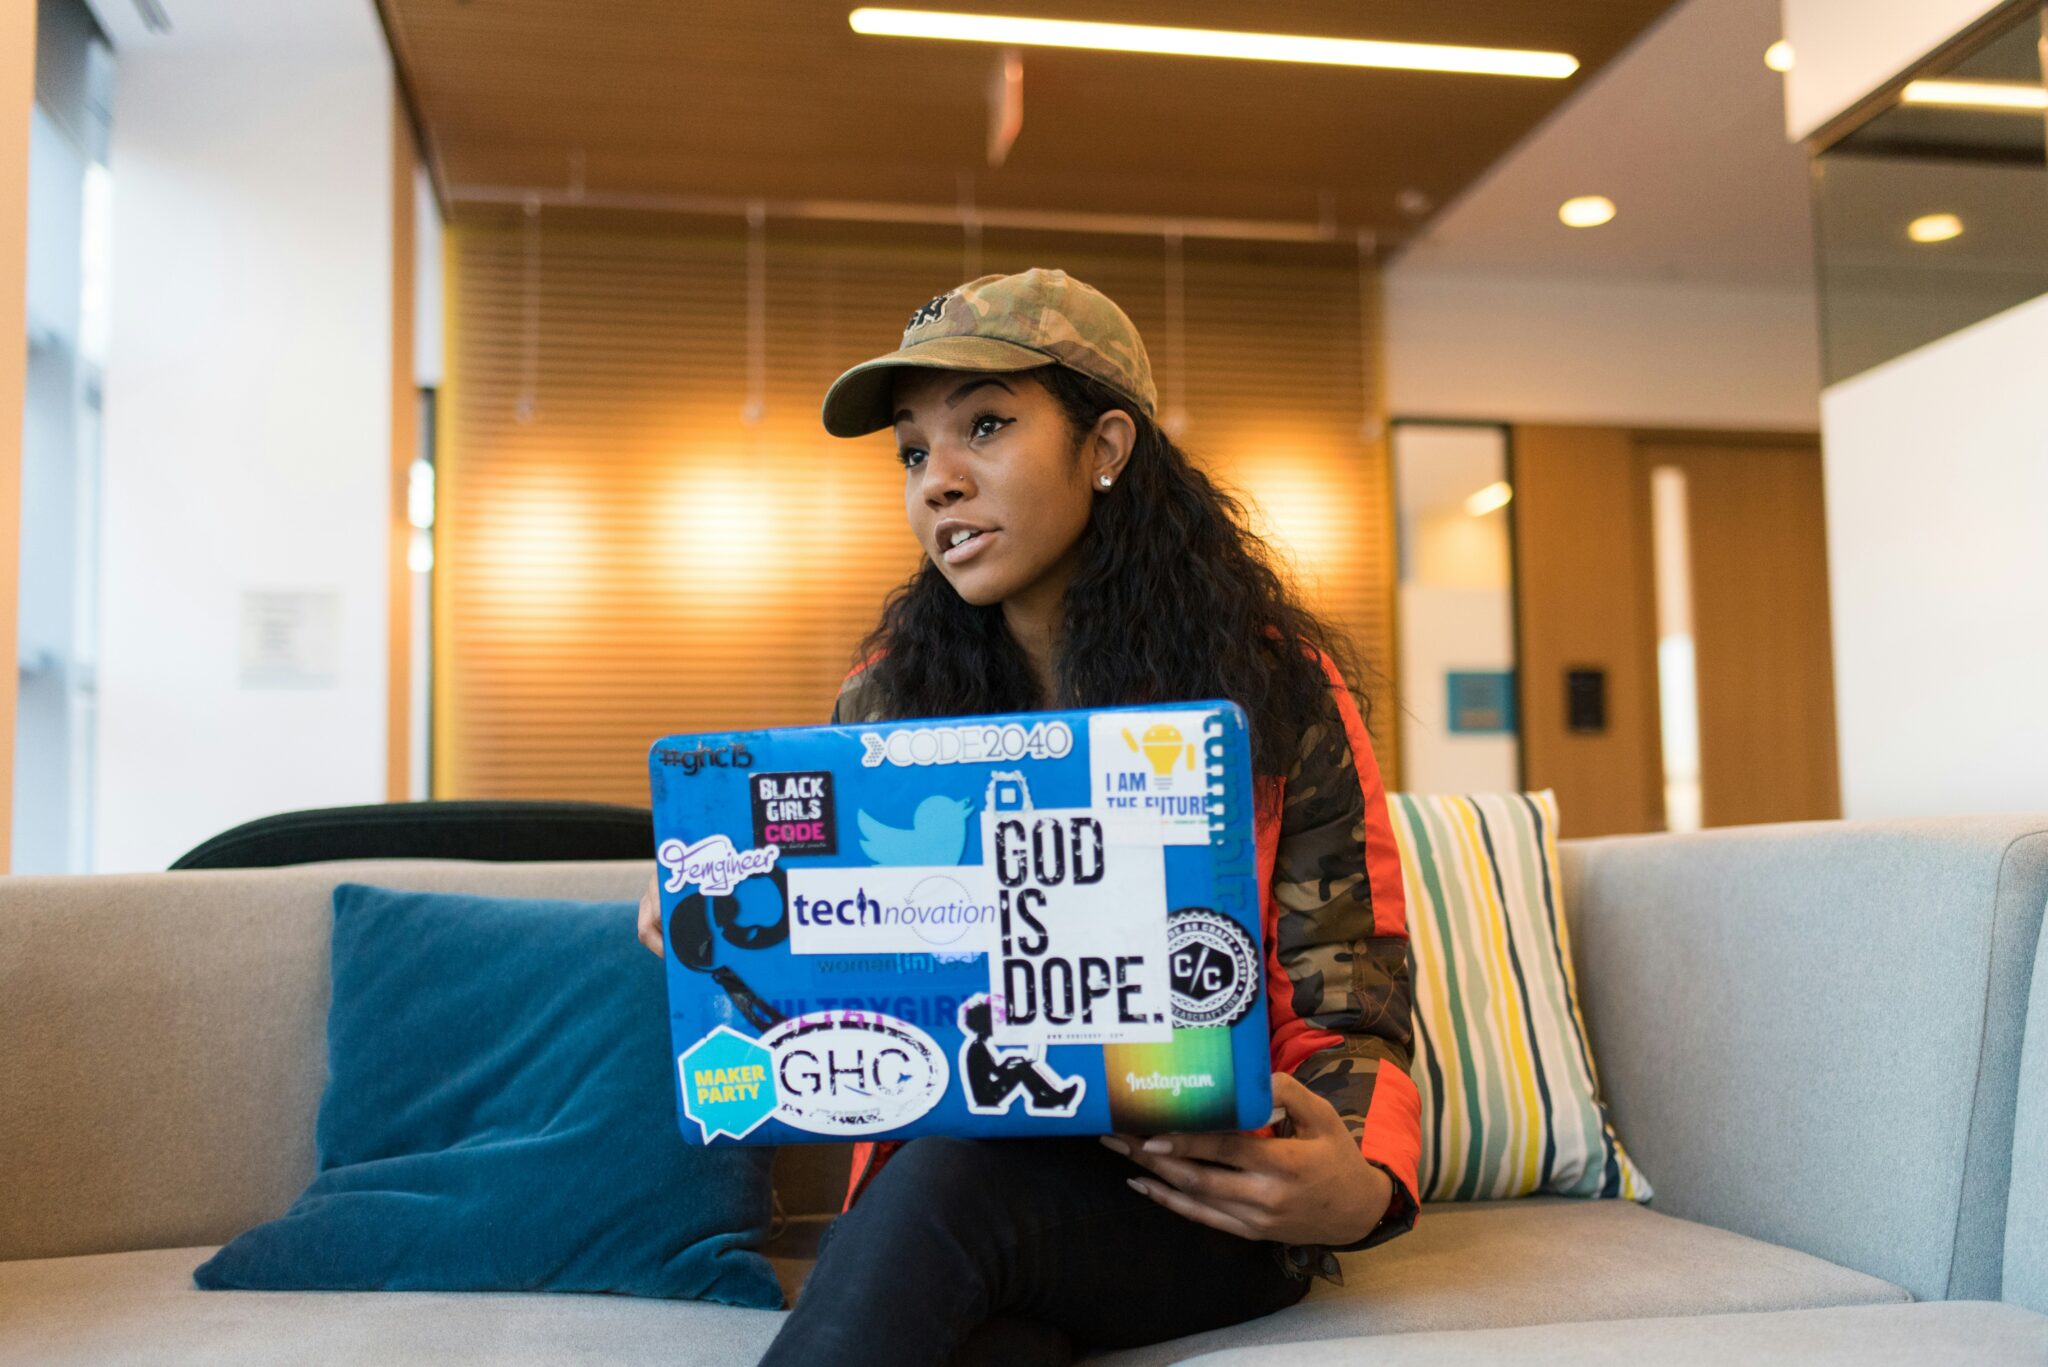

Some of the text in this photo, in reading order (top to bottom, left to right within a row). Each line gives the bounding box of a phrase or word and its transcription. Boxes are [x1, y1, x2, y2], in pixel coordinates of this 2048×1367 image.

[658, 741, 753, 776] #ghc15
[886, 727, 1069, 763] CODE2040
[759, 776, 825, 800] BLACK
[1105, 772, 1146, 791] I AM
[766, 799, 822, 822] GIRLS
[765, 822, 827, 843] CODE
[663, 840, 775, 891] Femgineer
[994, 817, 1105, 888] GOD
[793, 887, 996, 928] technovation
[999, 888, 1049, 956] IS
[1201, 922, 1236, 946] CRAFT
[1003, 956, 1165, 1026] DOPE.
[694, 1065, 766, 1086] MAKER
[780, 1048, 911, 1097] GHC
[1126, 1071, 1215, 1096] Instagram
[698, 1082, 761, 1104] PARTY
